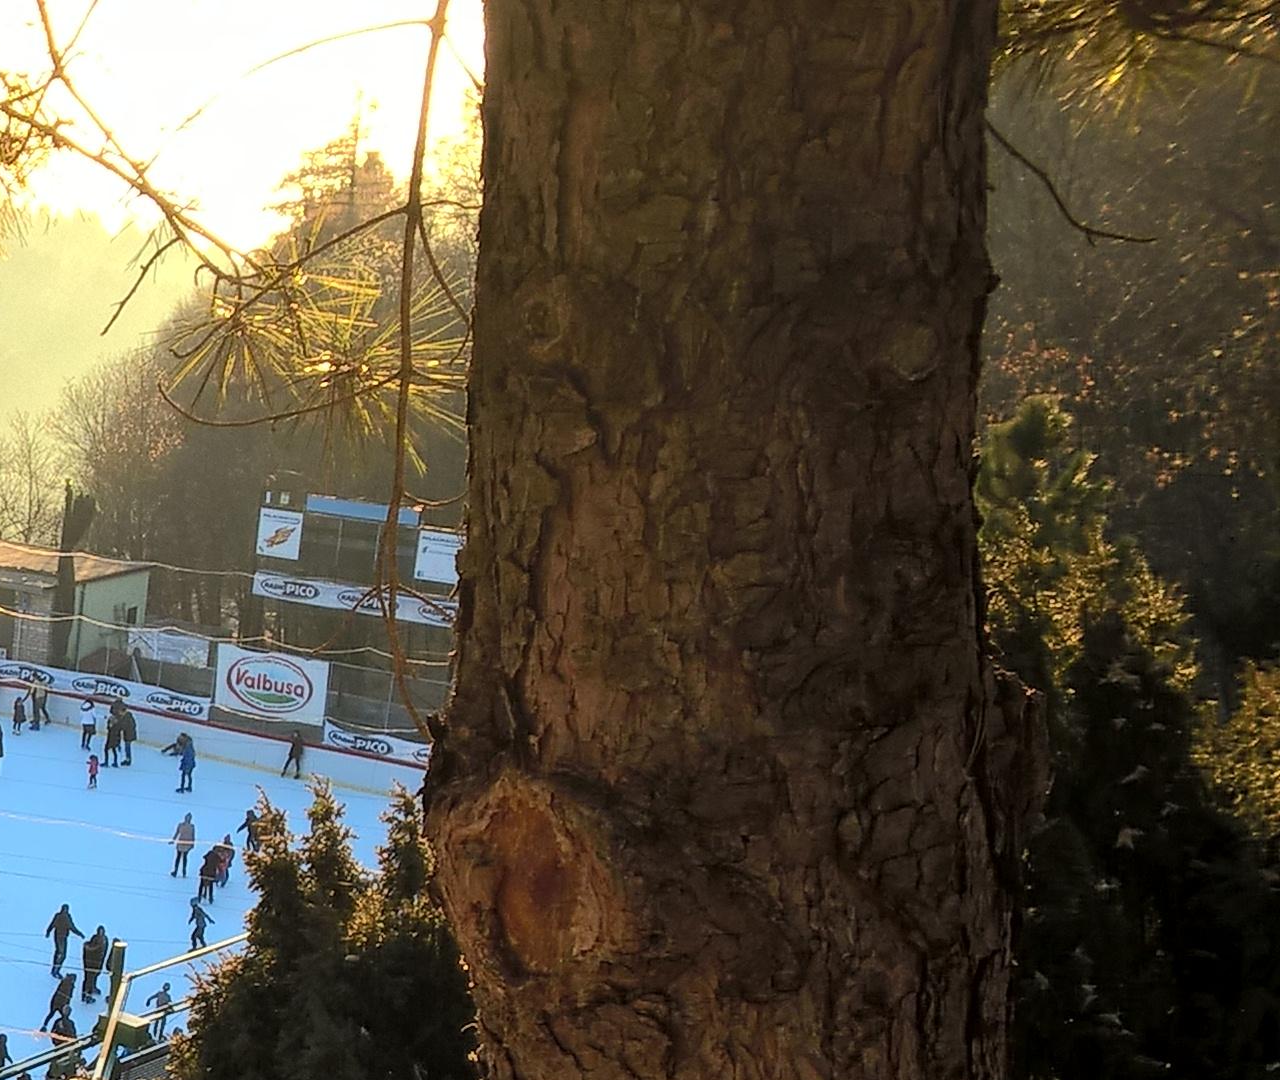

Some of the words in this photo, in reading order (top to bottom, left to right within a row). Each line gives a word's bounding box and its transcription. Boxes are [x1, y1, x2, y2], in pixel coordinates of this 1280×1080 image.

[263, 581, 287, 593] RADIO
[286, 583, 316, 598] PICO
[21, 669, 50, 684] PIO
[235, 667, 305, 698] Valbusa
[96, 682, 127, 697] PICO
[171, 700, 200, 714] PICO
[354, 738, 388, 754] PICO
